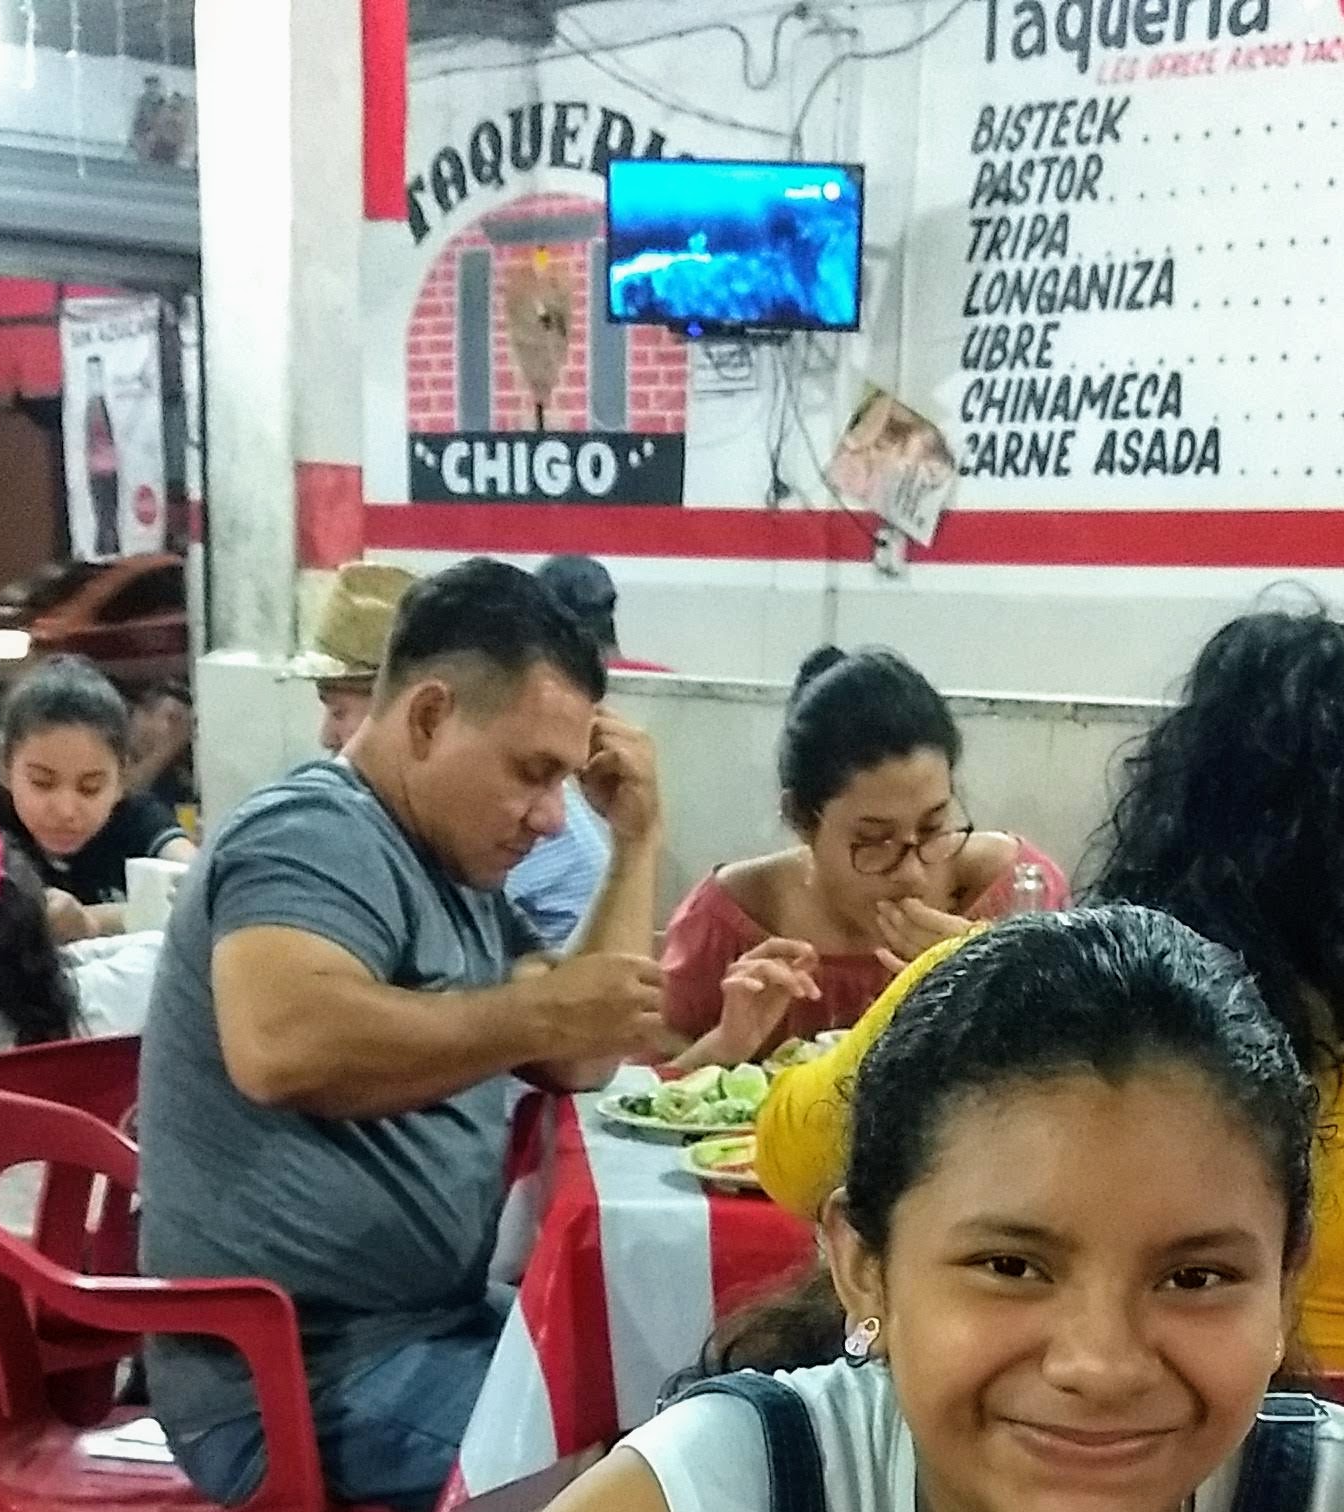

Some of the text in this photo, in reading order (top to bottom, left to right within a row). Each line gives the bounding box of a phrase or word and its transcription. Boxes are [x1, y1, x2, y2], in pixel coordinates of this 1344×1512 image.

[970, 97, 1131, 155] BISTECK
[408, 100, 696, 245] TAQUER
[970, 153, 1105, 209] PASTOR
[965, 212, 1071, 264] TRIPA
[962, 259, 1175, 317] LONGANIZA
[960, 320, 1060, 373] UBRE
[959, 372, 1183, 424] CHINAMECA
[1093, 425, 1222, 477] ASADA
